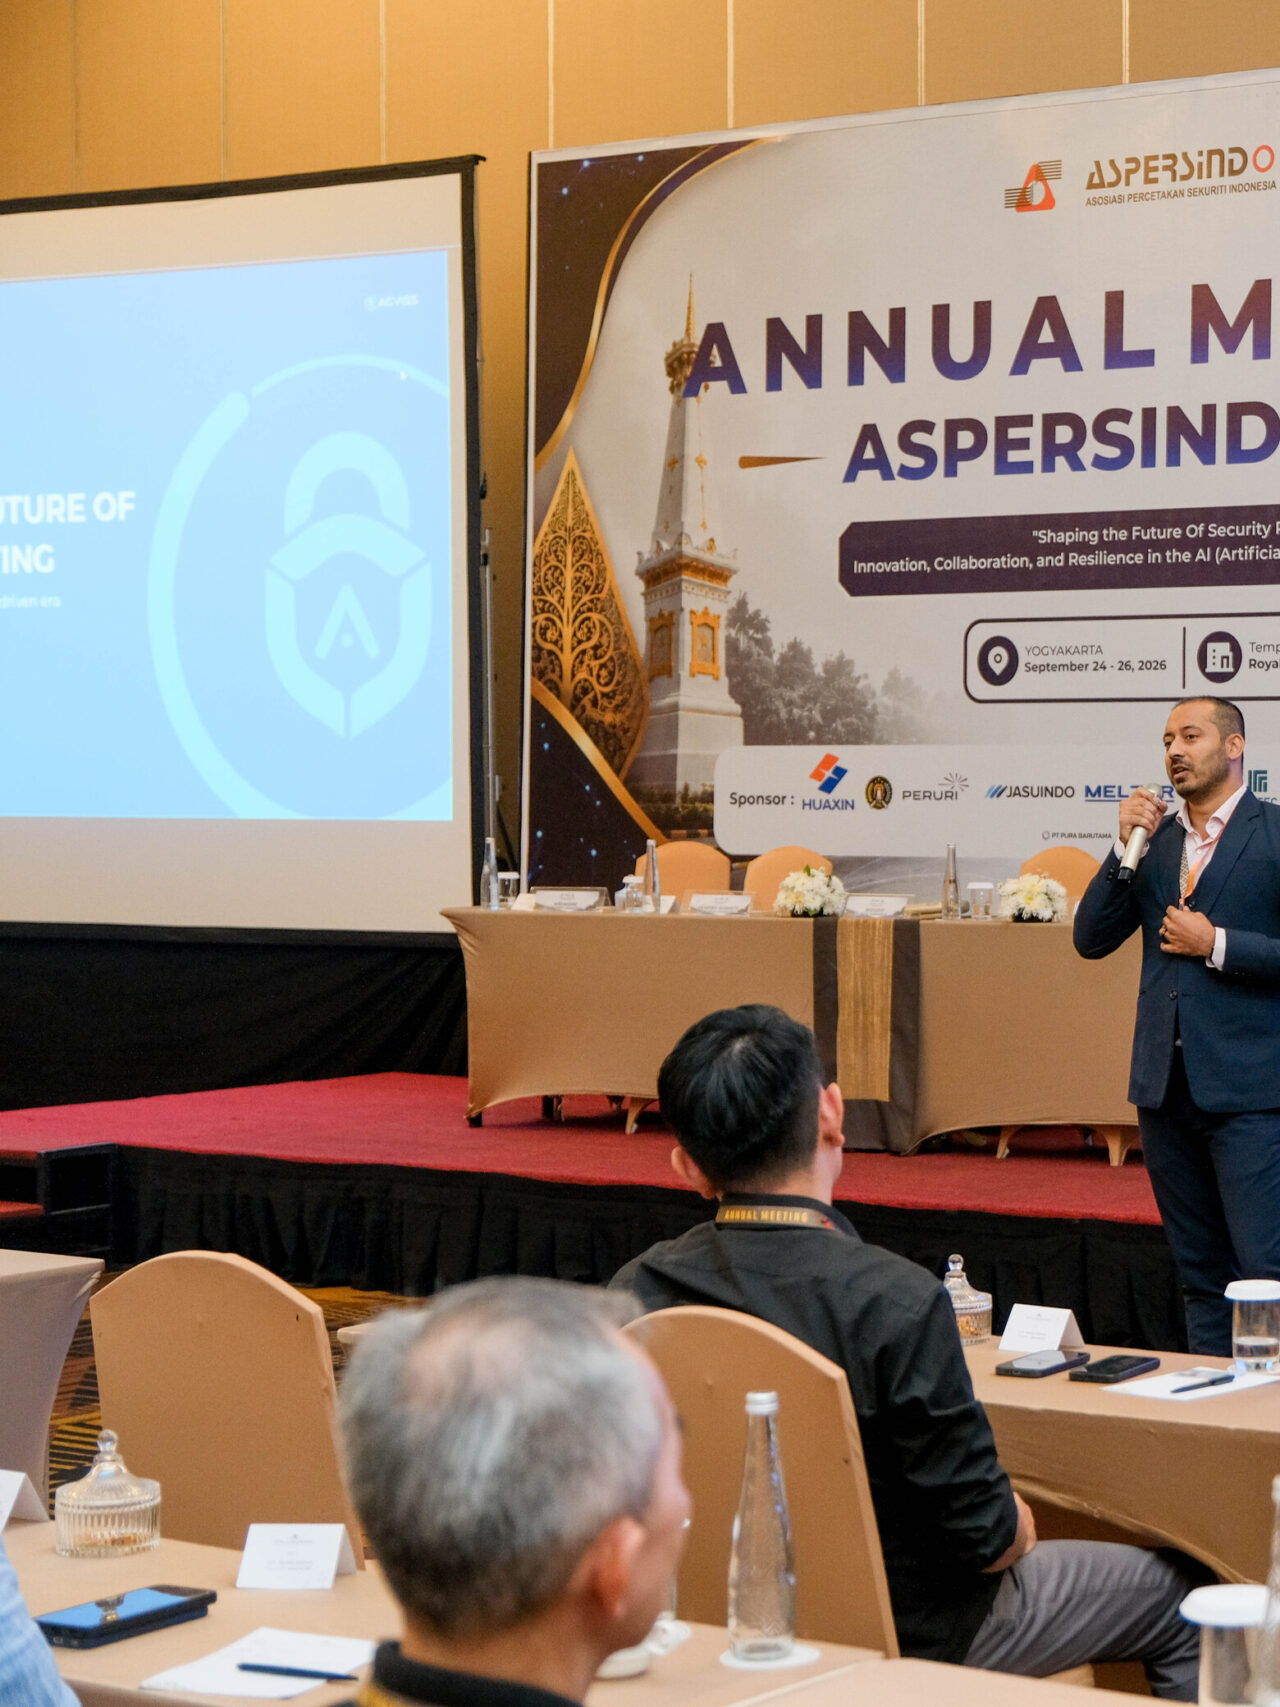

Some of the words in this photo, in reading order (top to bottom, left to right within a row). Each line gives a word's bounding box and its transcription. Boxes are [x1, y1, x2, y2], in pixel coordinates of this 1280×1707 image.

[1086, 194, 1125, 206] ASOSIASI
[1127, 189, 1184, 202] PERCETAKAN
[1187, 185, 1226, 197] SEKURITI
[1229, 180, 1277, 193] INDONESIA
[682, 290, 1155, 398] ANNUAL
[0, 493, 86, 524] TURE
[93, 490, 136, 521] OF
[1102, 527, 1128, 541] the
[1132, 527, 1182, 540] Future
[1186, 523, 1205, 538] Of
[1208, 521, 1271, 539] Security
[0, 544, 55, 574] ING
[854, 557, 931, 573] Innovation,
[934, 554, 1033, 570] Collaboration,
[1037, 552, 1064, 567] and
[1069, 550, 1143, 566] Resilience
[1148, 549, 1162, 563] in
[1165, 549, 1191, 563] the
[1195, 547, 1210, 562] AI
[1025, 645, 1103, 656] YOGYAKARTA
[1025, 661, 1089, 674] September
[1093, 661, 1107, 671] 24
[1118, 661, 1134, 672] 26,
[1138, 660, 1166, 670] 2026
[902, 791, 957, 800] PERURI
[1005, 786, 1075, 798] JASUINDO
[1084, 785, 1174, 798] MELR
[730, 792, 786, 808] Sponsor
[802, 799, 854, 810] HUAXIN
[761, 1209, 810, 1223] MEETING
